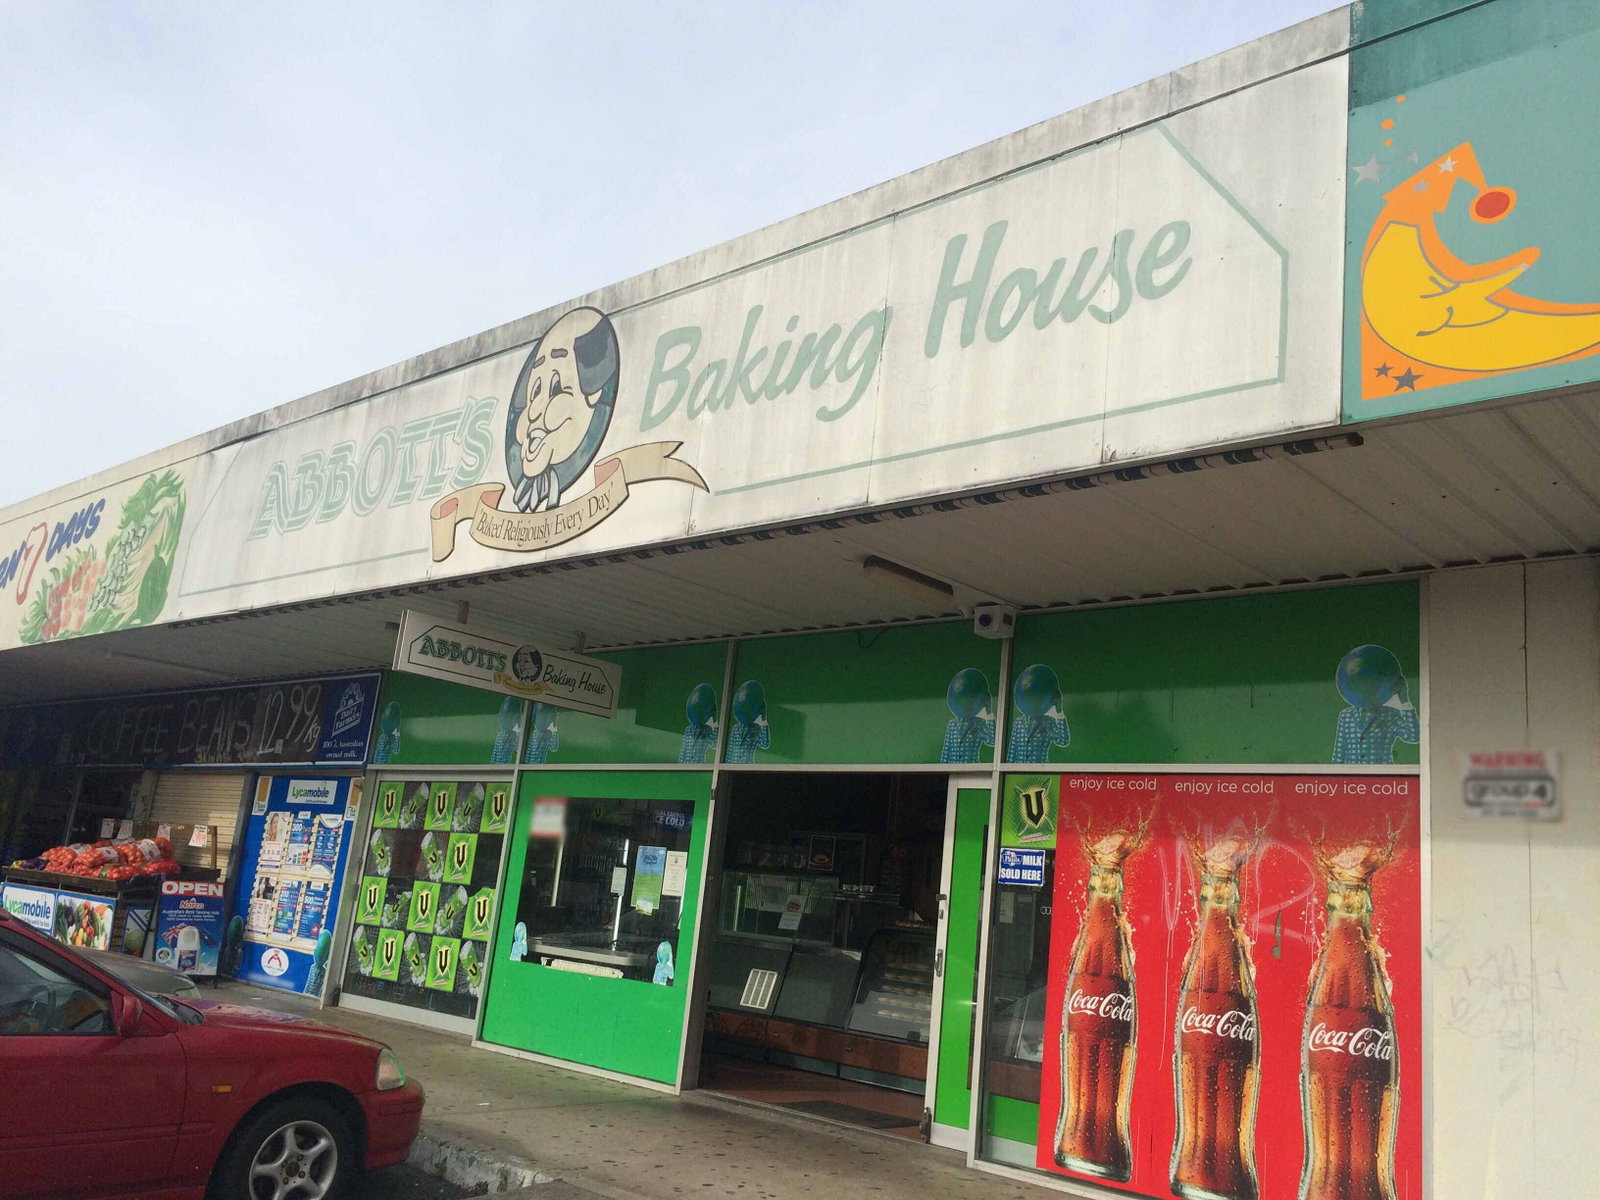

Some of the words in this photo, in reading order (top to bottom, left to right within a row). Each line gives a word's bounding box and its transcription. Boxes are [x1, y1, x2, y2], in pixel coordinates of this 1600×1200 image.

[640, 305, 894, 433] Baking
[924, 220, 1193, 359] House
[248, 395, 499, 541] ABBOTT'S
[504, 516, 552, 547] Religiously
[555, 509, 585, 536] Every
[16, 522, 48, 605] 7
[46, 498, 106, 563] DAYS
[542, 665, 577, 693] Baking
[578, 671, 607, 695] House
[292, 786, 330, 799] Lycamobile
[1069, 778, 1103, 791] enjoy
[1106, 778, 1125, 790] ice
[1128, 778, 1157, 790] cold
[1175, 780, 1213, 794] enjoy
[1217, 780, 1239, 793] ice
[1242, 780, 1274, 794] cold
[1295, 781, 1337, 797] enjoy
[1342, 781, 1367, 795] ice
[1372, 781, 1408, 795] cold
[1022, 789, 1044, 825] V
[1000, 868, 1020, 880] SOLD
[1021, 869, 1042, 881] HERE
[1022, 855, 1043, 866] MILK
[161, 880, 224, 897] OPEN
[1069, 988, 1133, 1022] Coca-Cola
[1182, 1005, 1257, 1041] Coca-Cola
[1309, 1022, 1394, 1061] Coca-Cola
